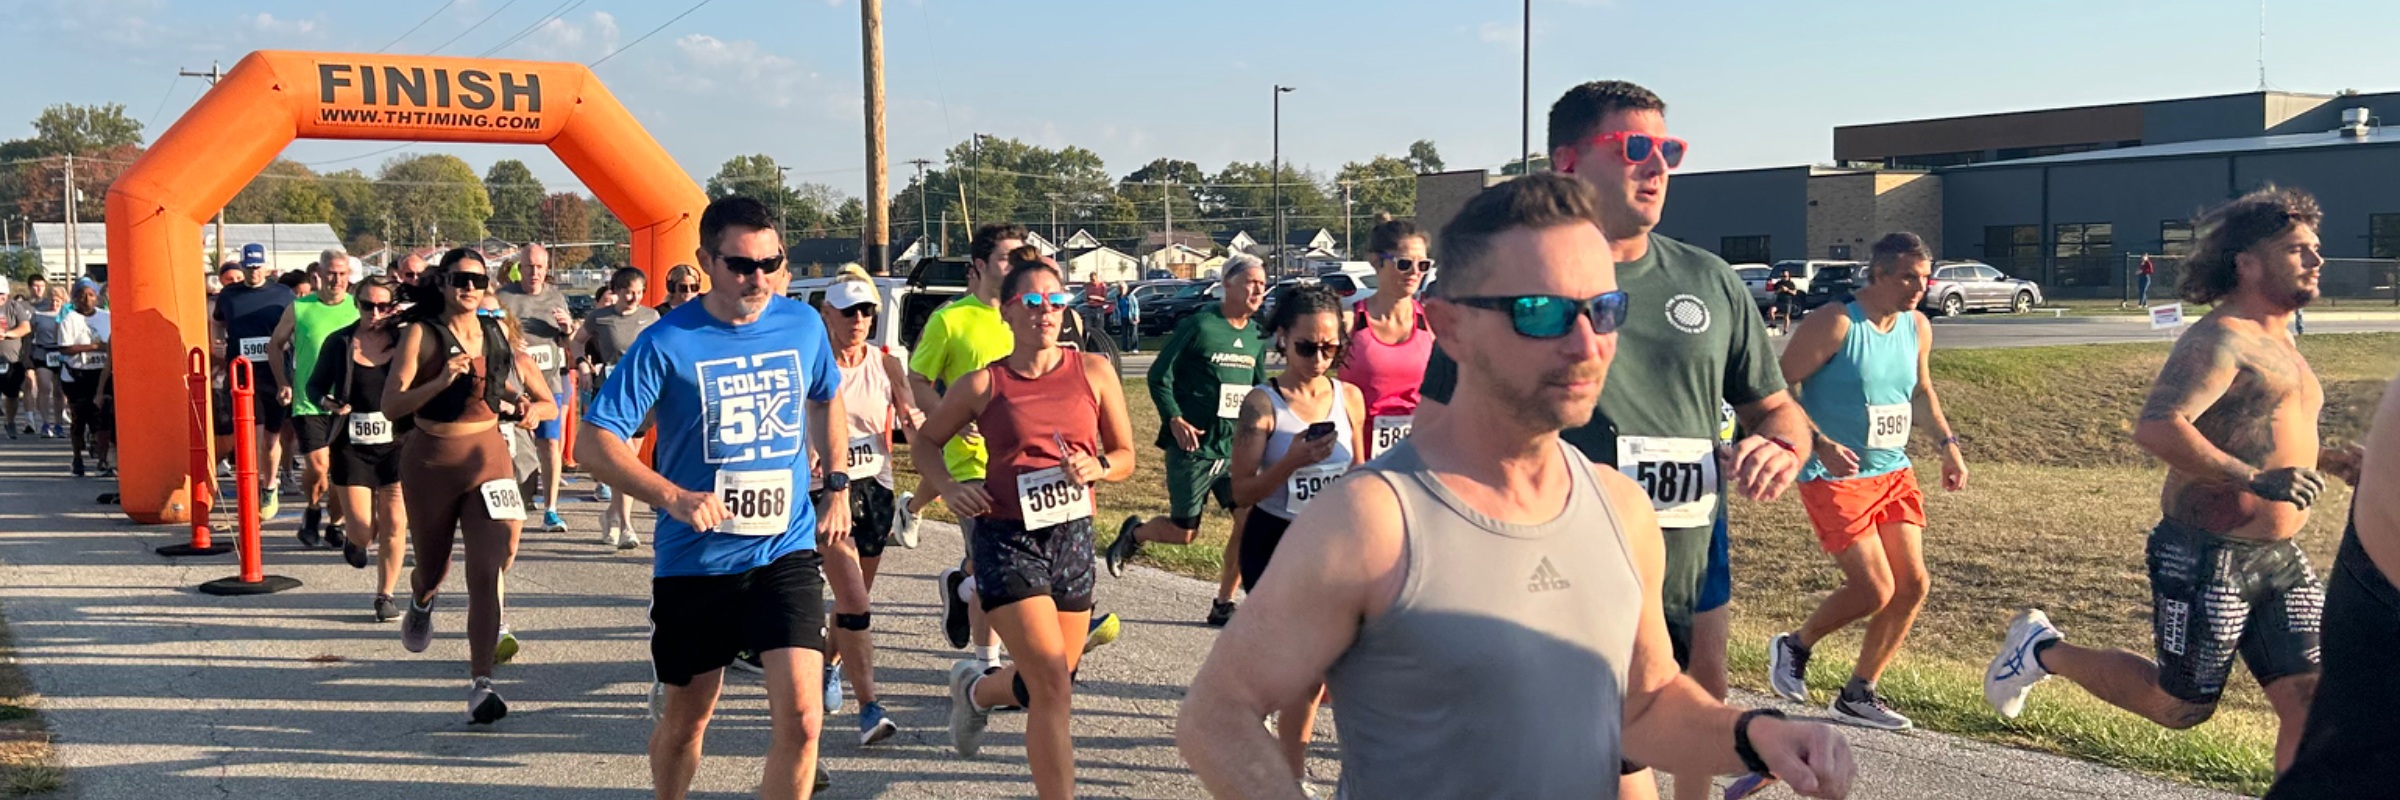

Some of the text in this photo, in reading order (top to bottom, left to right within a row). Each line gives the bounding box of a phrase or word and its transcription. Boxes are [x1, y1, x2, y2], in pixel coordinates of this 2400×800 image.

[318, 64, 541, 112] FINISH
[321, 108, 540, 129] WWW.THTIMING.COM
[717, 368, 790, 396] COLTS
[355, 421, 385, 435] 5867
[720, 391, 800, 445] 5K
[1877, 414, 1907, 435] 5981
[1638, 461, 1703, 503] 5871
[724, 487, 785, 518] 5868
[1527, 577, 1571, 592] adidas
